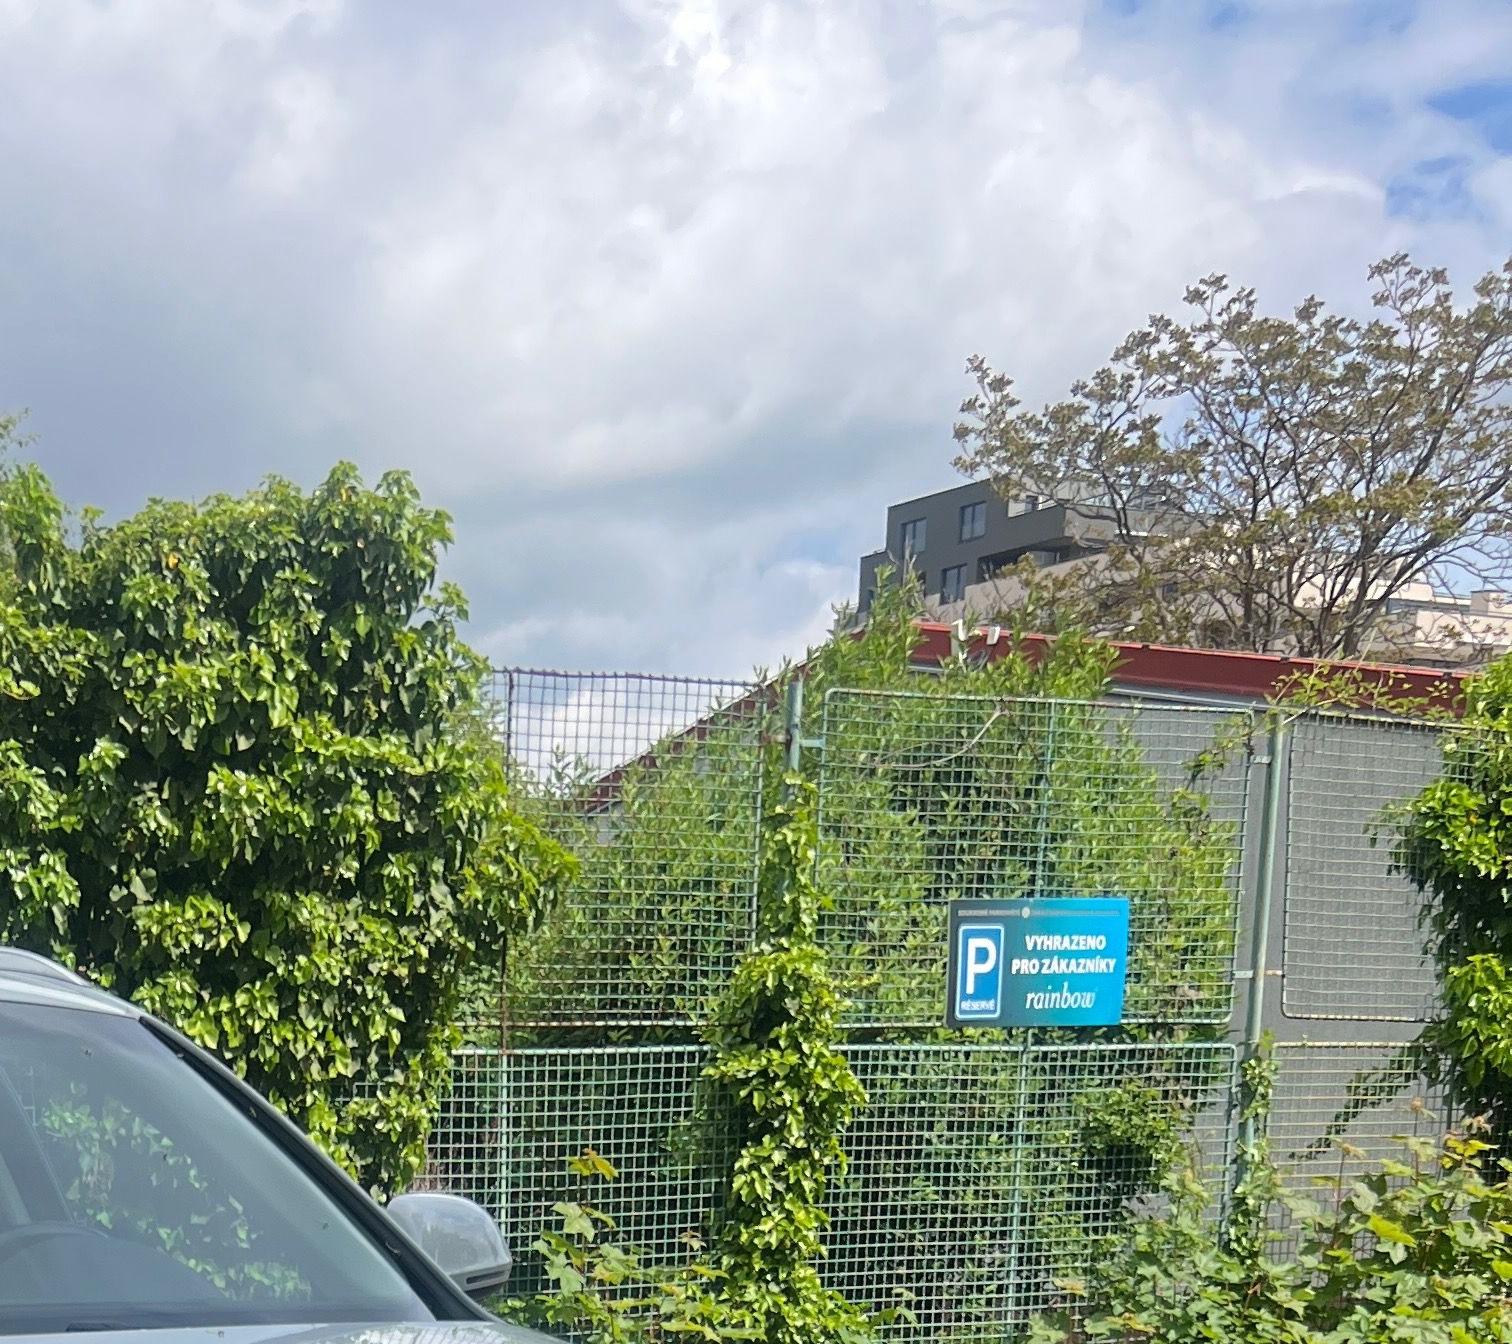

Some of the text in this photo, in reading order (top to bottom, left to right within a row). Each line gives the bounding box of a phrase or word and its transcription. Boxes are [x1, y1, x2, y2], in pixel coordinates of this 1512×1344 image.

[1025, 935, 1106, 951] VYHRAZENO
[965, 938, 997, 994] P
[1011, 954, 1116, 974] PRO ZÁKAZNÍKY
[1025, 981, 1096, 1009] rainbow
